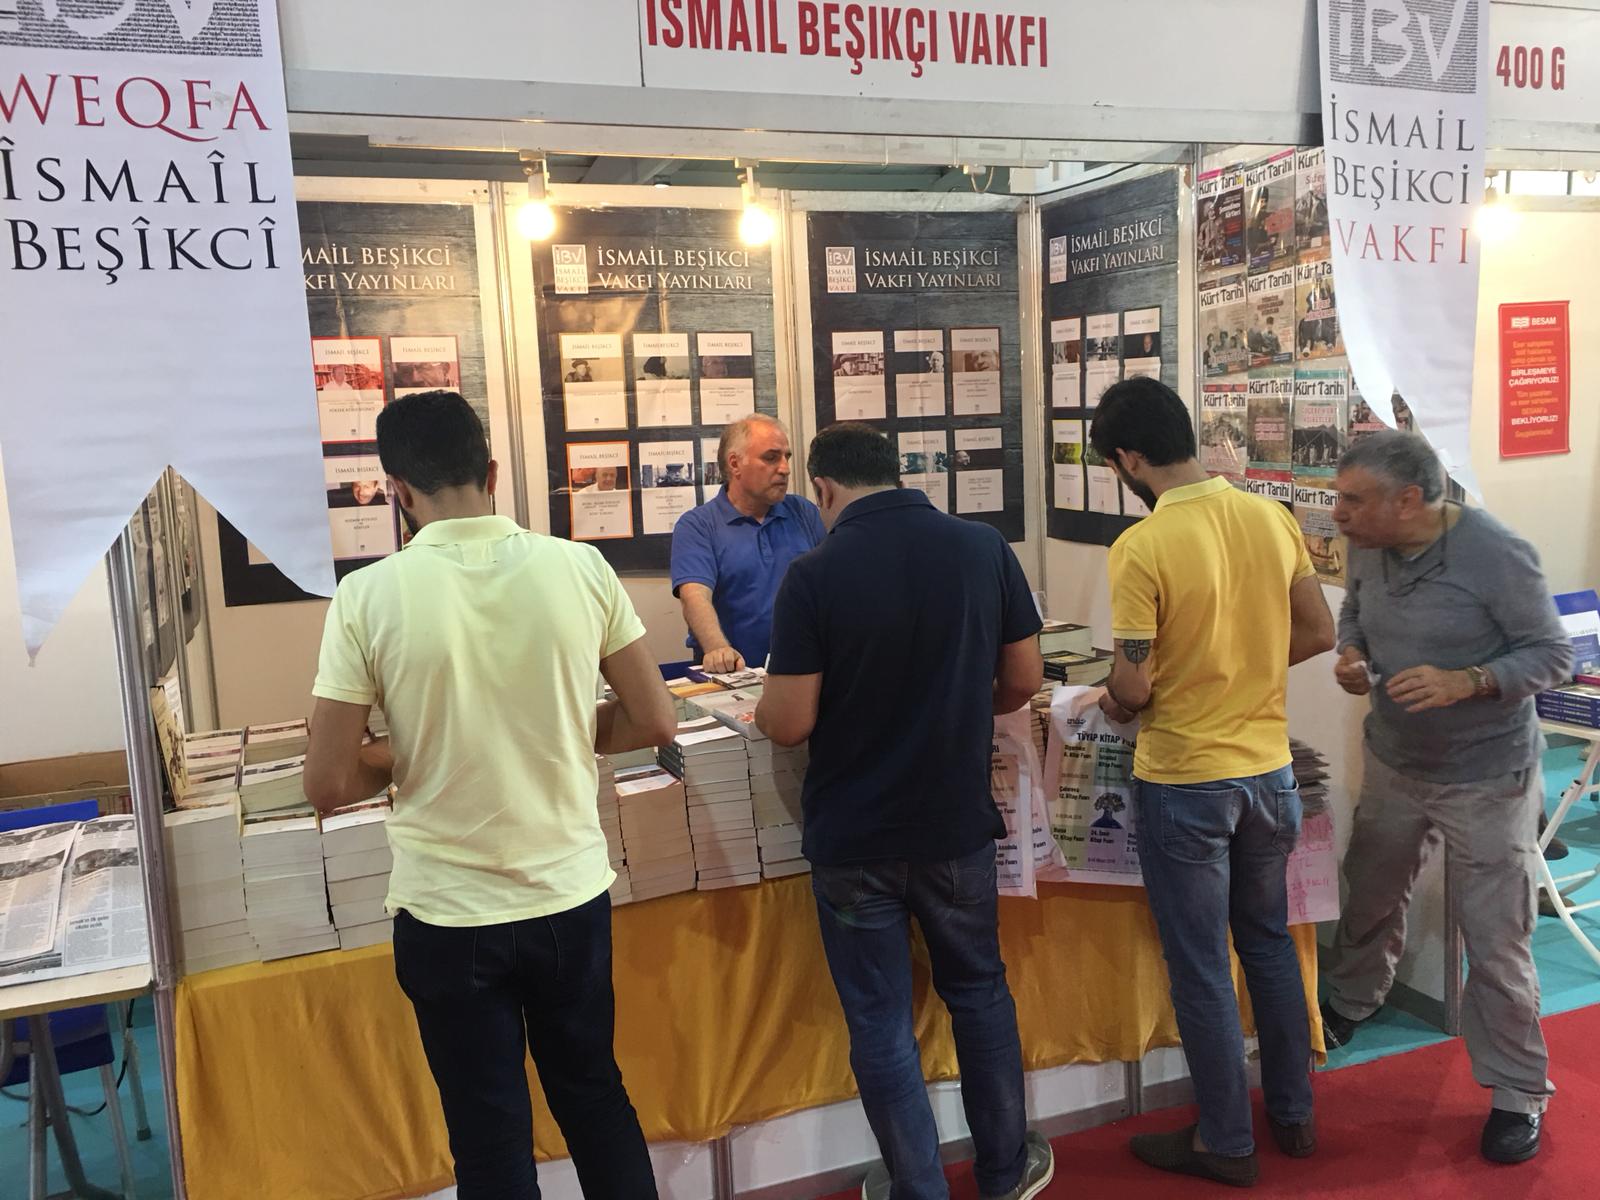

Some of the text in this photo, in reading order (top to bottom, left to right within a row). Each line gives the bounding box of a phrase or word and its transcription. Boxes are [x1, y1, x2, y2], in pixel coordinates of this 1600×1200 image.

[799, 2, 939, 78] BEŞIKÇI
[949, 11, 1048, 68] VAKFI
[1496, 45, 1566, 90] 400 G
[0, 73, 272, 142] WEQFA
[1330, 93, 1475, 151] İSMAİL
[1246, 157, 1293, 187] Kürt Tarihi
[1298, 152, 1320, 170] Kürt
[1333, 156, 1470, 211] BEŞİKCİ
[1071, 214, 1162, 254] İSMAİL BEŞİKCİ
[1336, 218, 1469, 263] VAKFI
[4, 216, 280, 285] BEŞÎKCÎ
[302, 243, 451, 269] MAİL BEŞİKCİ
[598, 246, 750, 270] İSMAİL BEŞİKCİ
[865, 248, 1000, 270] İSMAİL BEŞİKCİ
[1071, 244, 1164, 275] VAKFI YAYINLARI
[303, 272, 456, 290] KFI YAYINLARI
[598, 272, 753, 290] VAKFI YAYINLARI
[864, 272, 1001, 288] VAKFI YAYINLARI
[1248, 269, 1293, 293] Kürt Tarihi
[1297, 264, 1318, 280] Kürt
[1200, 286, 1244, 307] Kürt Tarihi
[1249, 380, 1269, 394] Kürt
[1295, 381, 1317, 396] Kürt
[1203, 394, 1222, 407] Kürt
[1246, 480, 1290, 497] Kürt Tarihi
[1295, 488, 1316, 504] Kürt
[1100, 733, 1120, 743] KİTAP
